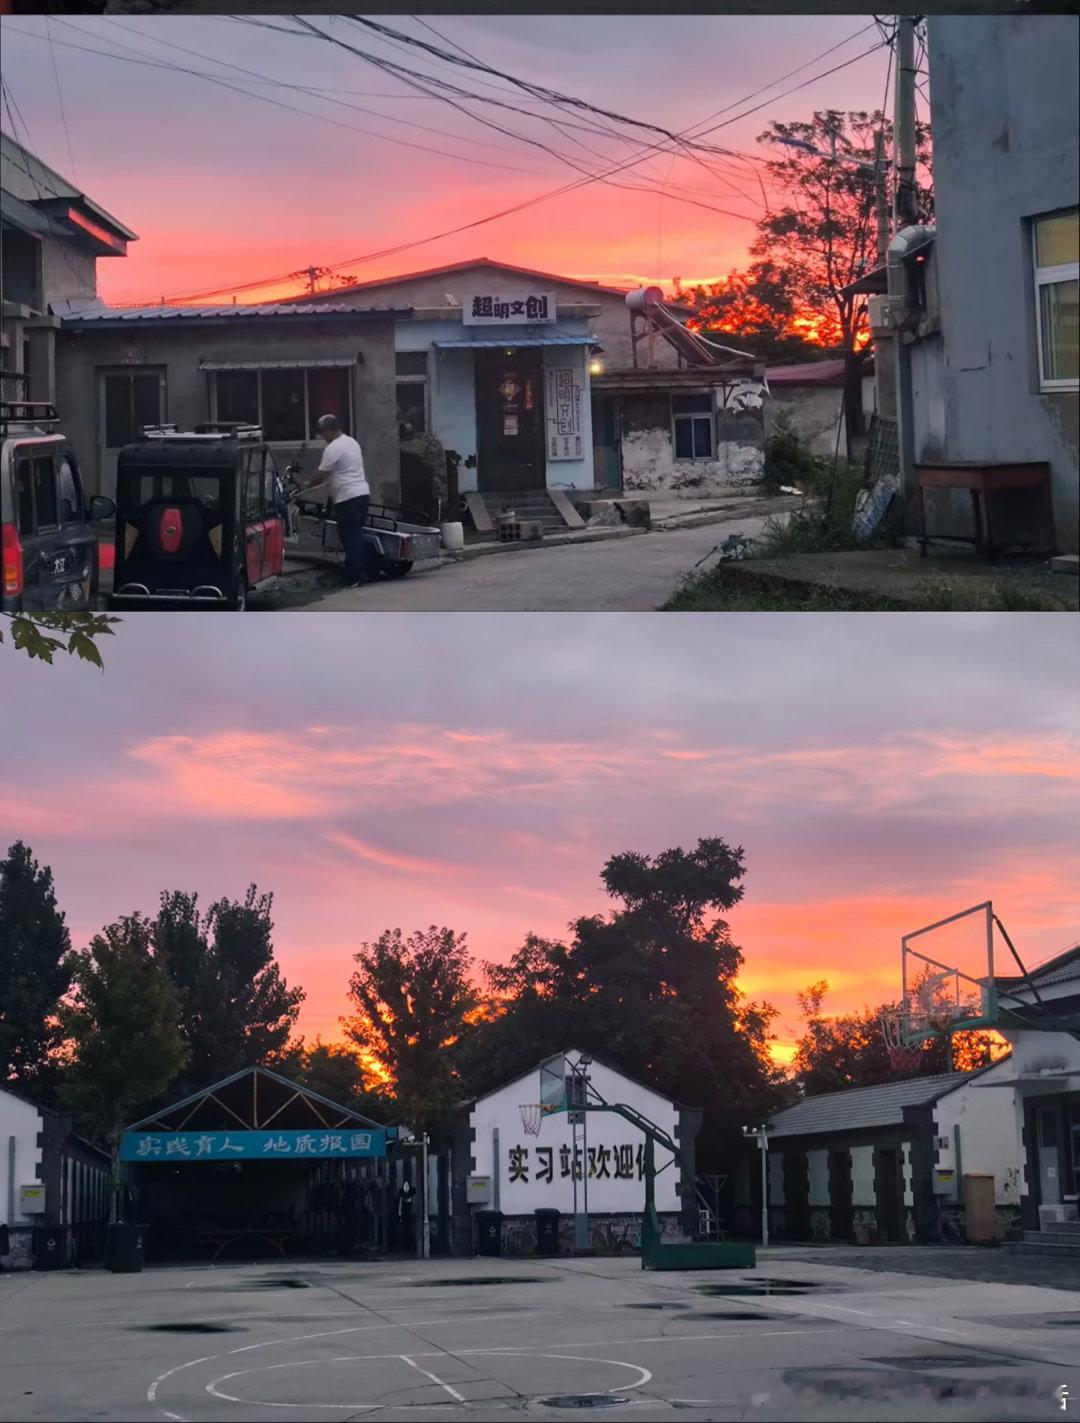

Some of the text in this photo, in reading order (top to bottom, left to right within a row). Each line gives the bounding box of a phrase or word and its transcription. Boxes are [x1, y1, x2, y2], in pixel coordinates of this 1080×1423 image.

[472, 295, 548, 319] 超明文创
[136, 1133, 373, 1157] 实践育人 地质报国
